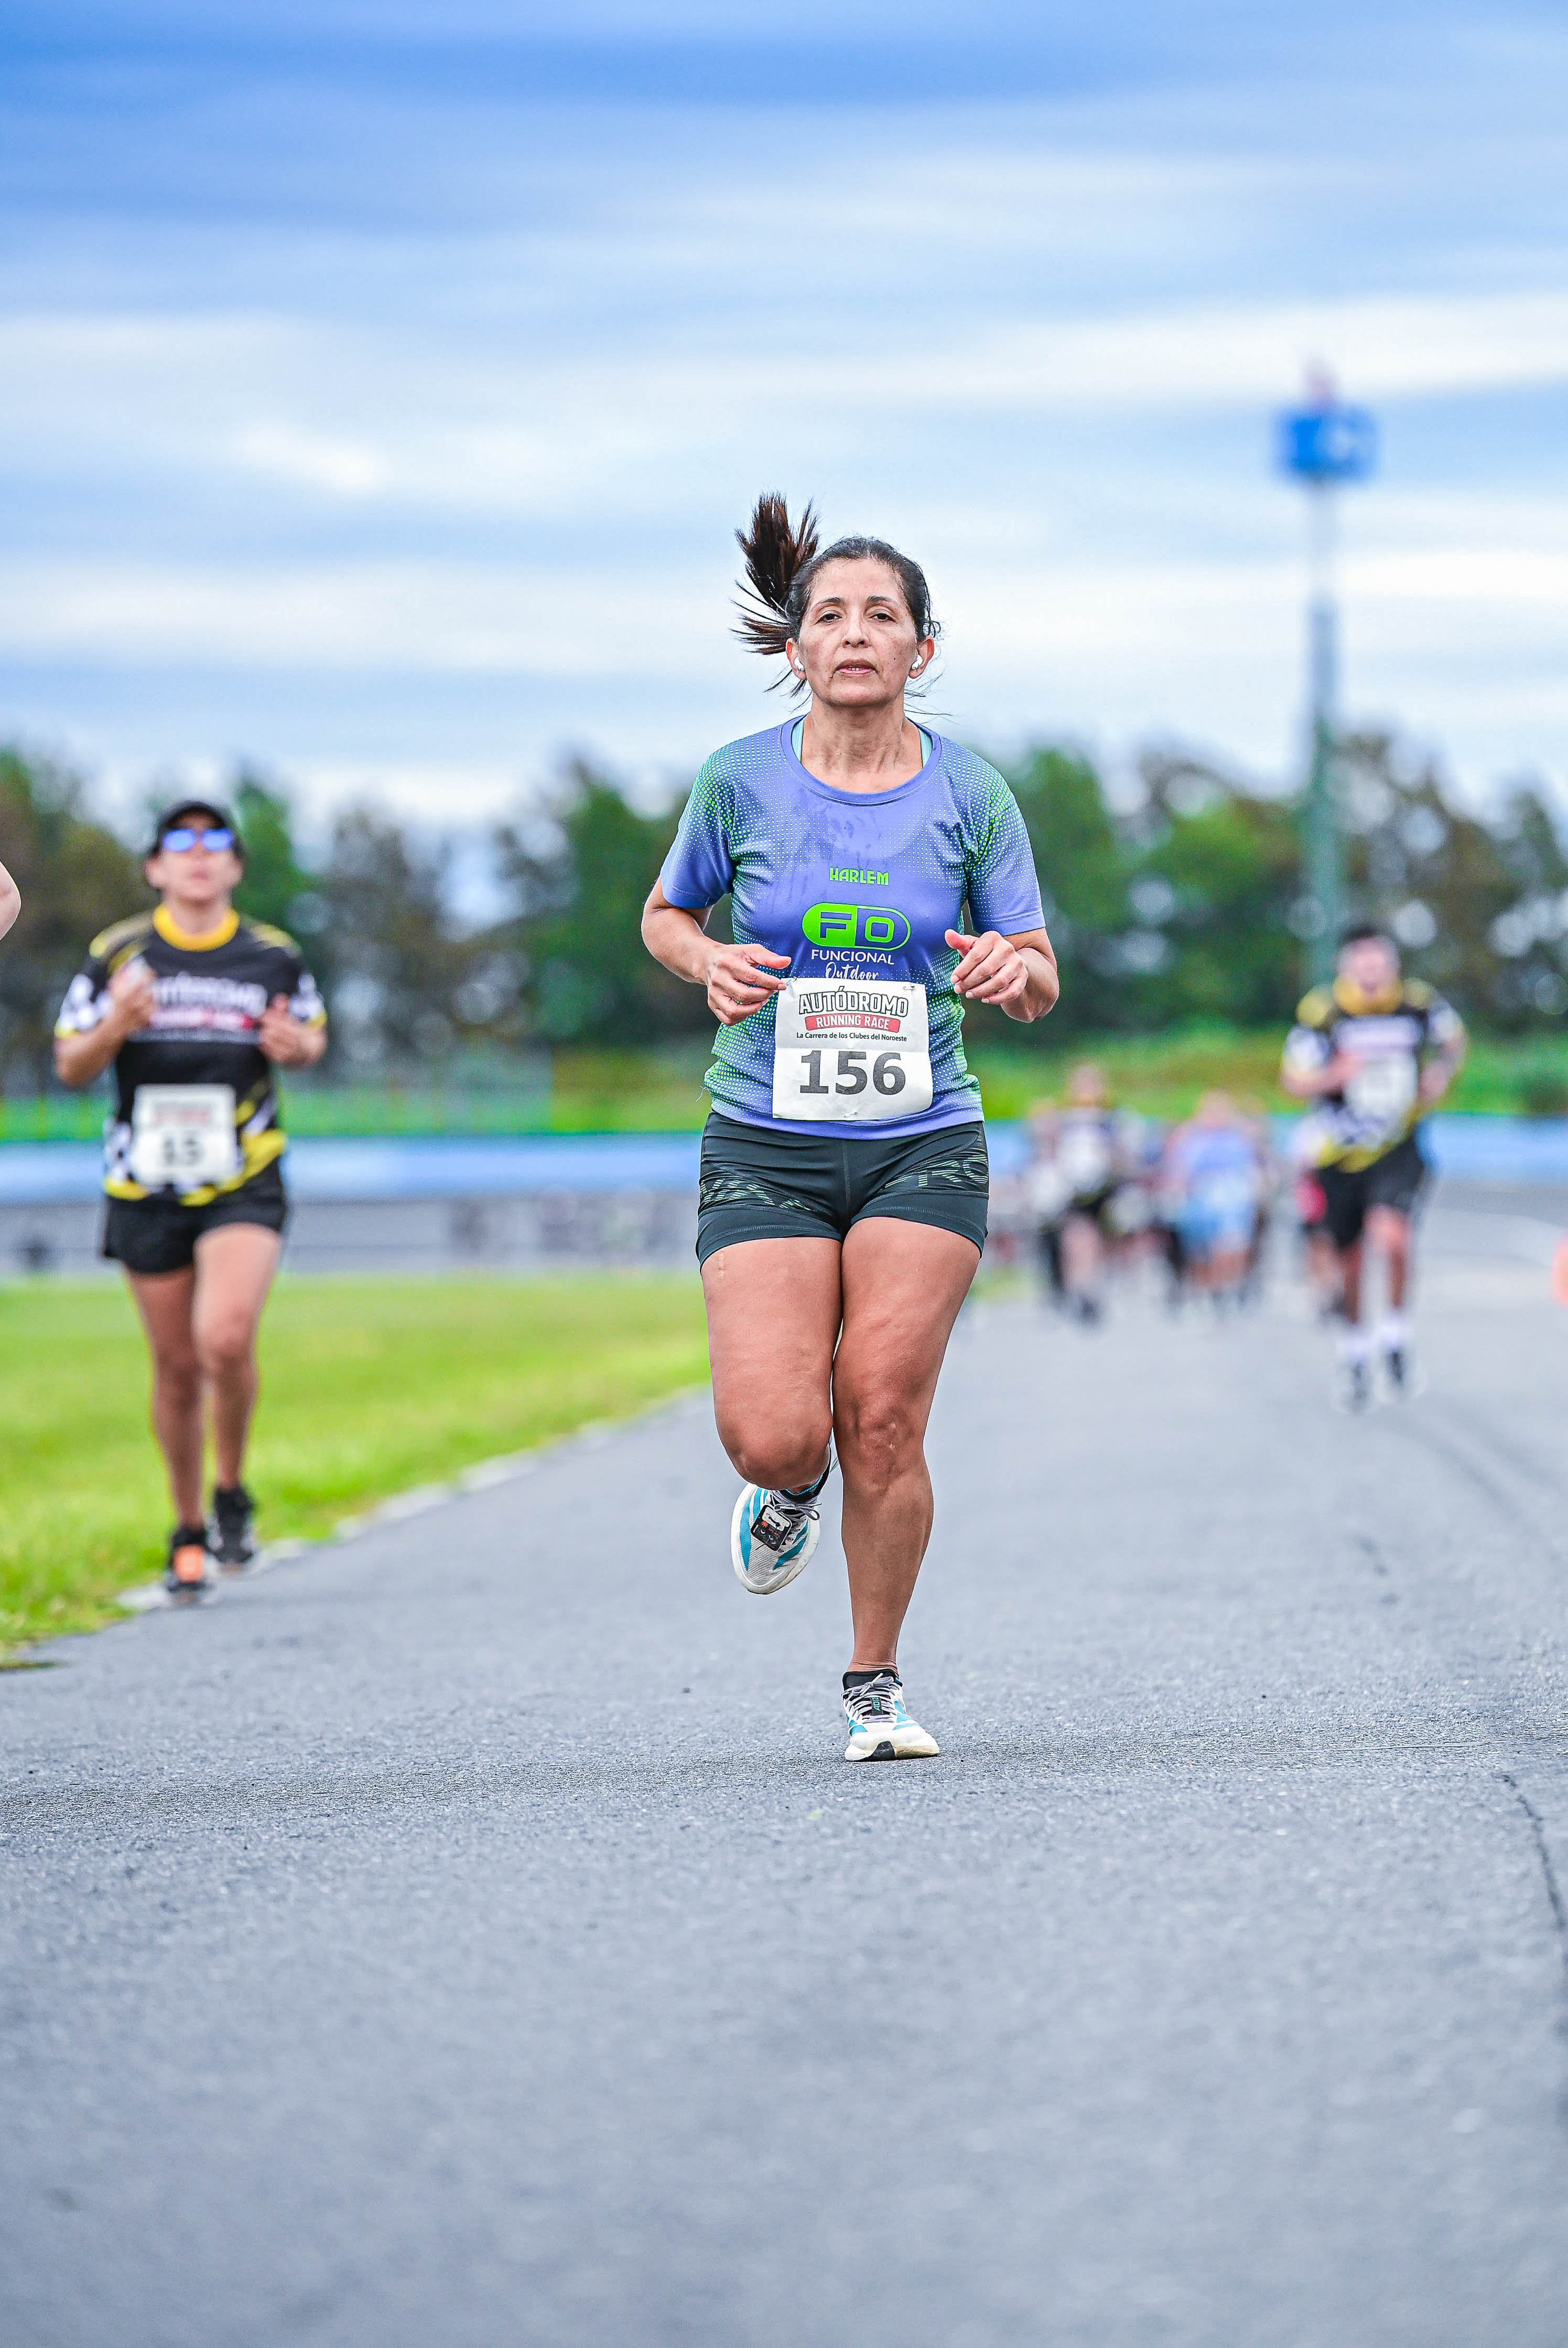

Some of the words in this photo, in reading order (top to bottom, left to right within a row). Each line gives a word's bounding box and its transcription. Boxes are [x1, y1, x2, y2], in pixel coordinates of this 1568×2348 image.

[829, 867, 889, 886] HARLEM
[811, 949, 895, 965] FUNCIONAL
[825, 962, 879, 980] Outdoor
[799, 986, 909, 1017] AUTÓDROMO
[816, 1015, 861, 1028] RUNNING
[864, 1015, 890, 1030] RACE
[800, 1050, 906, 1095] 156
